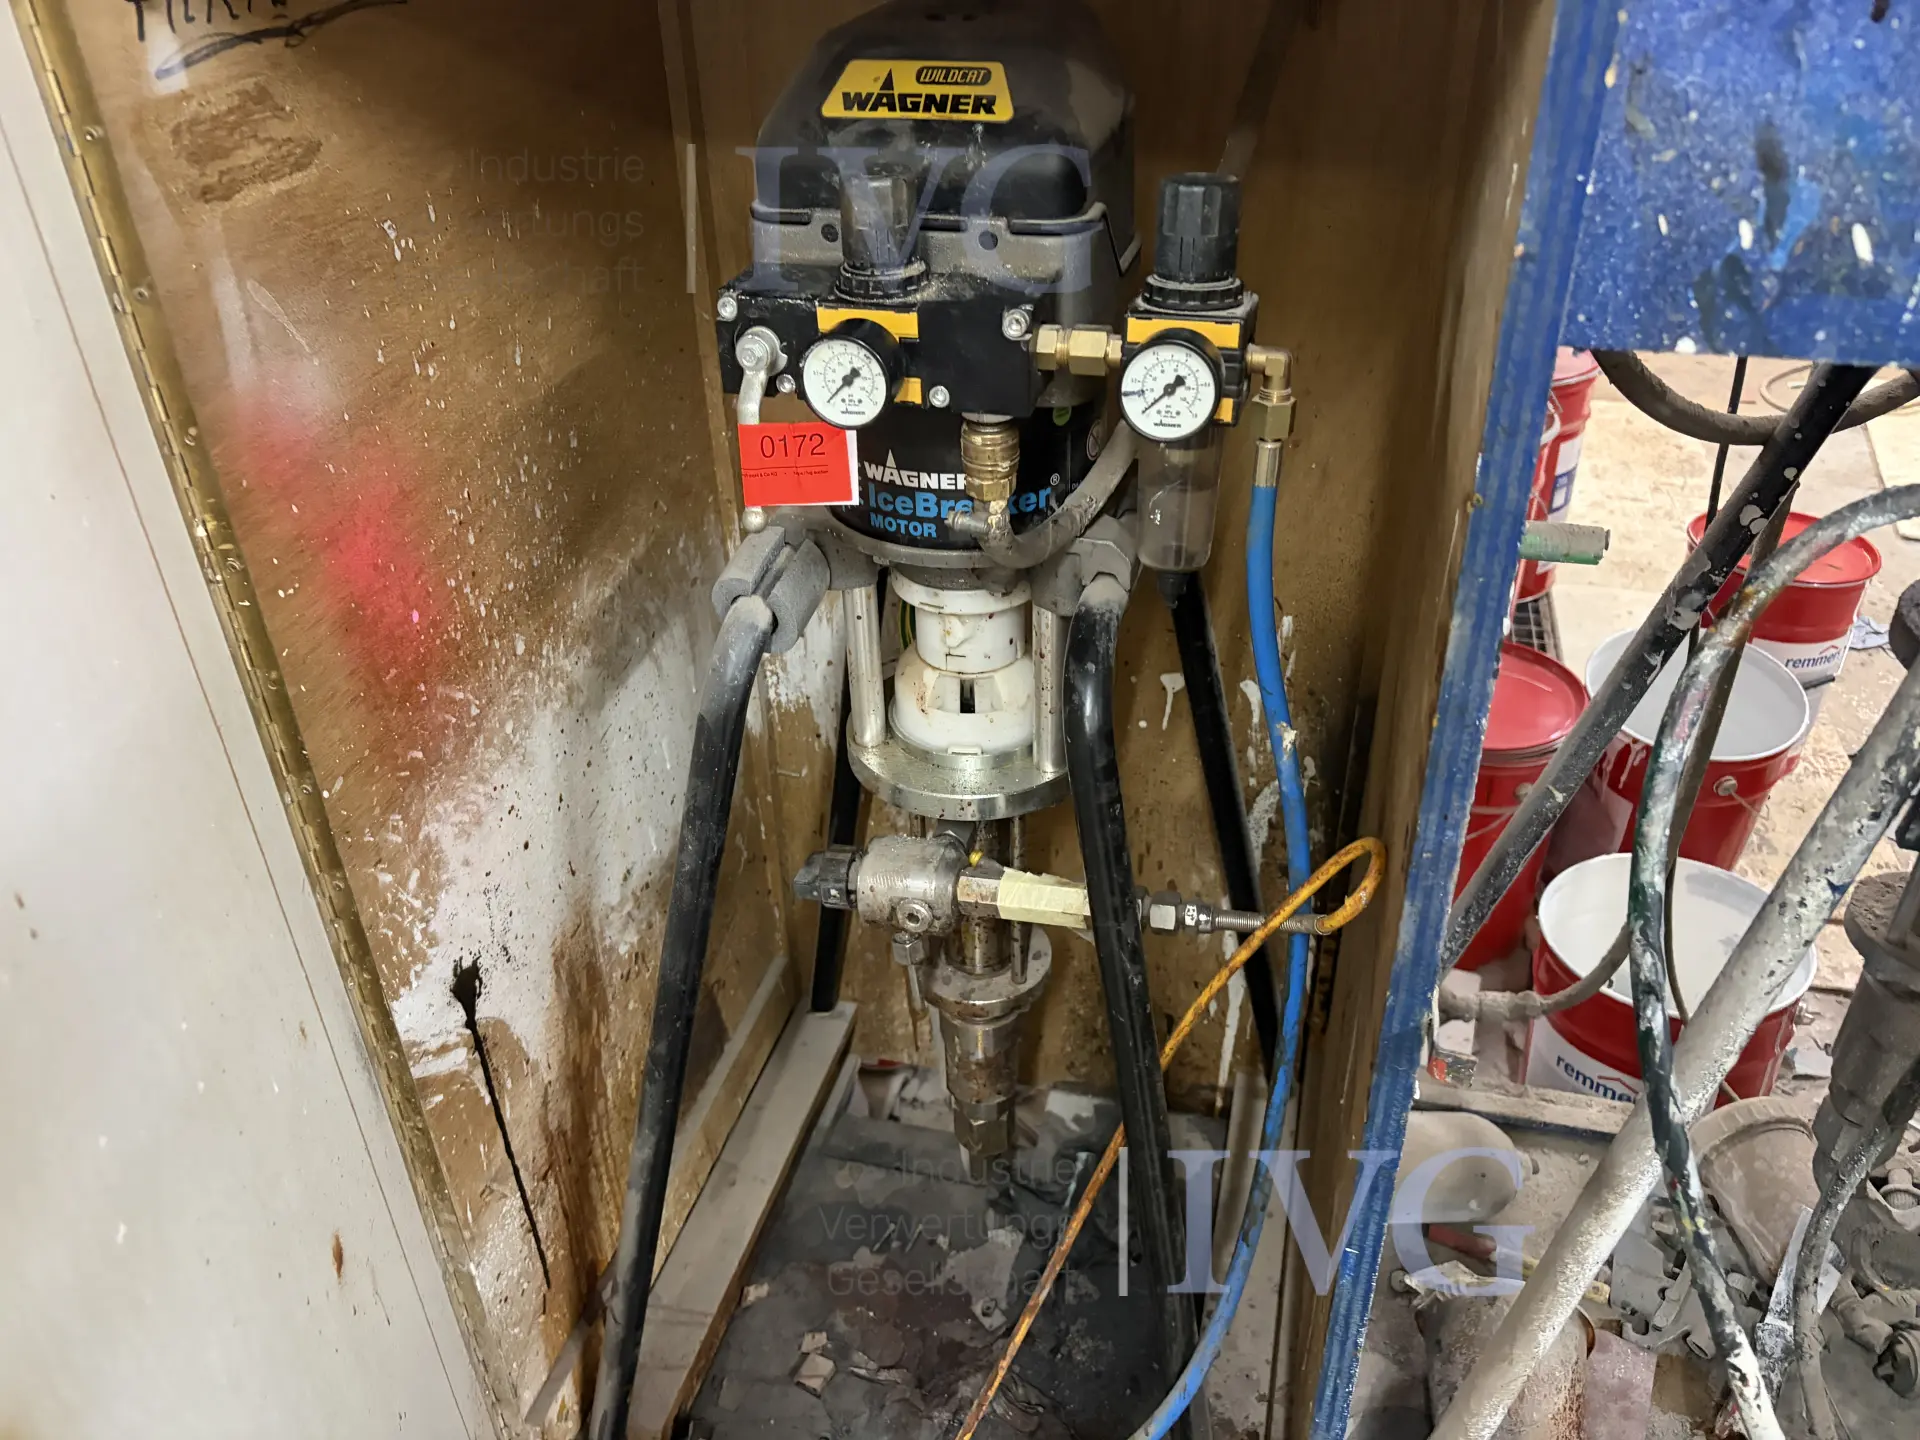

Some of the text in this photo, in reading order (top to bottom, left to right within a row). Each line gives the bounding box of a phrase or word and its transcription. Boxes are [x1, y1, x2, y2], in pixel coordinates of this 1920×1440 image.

[919, 69, 987, 83] WILDCAT
[842, 68, 997, 115] WAGNER
[760, 433, 826, 458] 0172
[870, 512, 937, 539] MOTOR
[1555, 1054, 1637, 1104] remme
